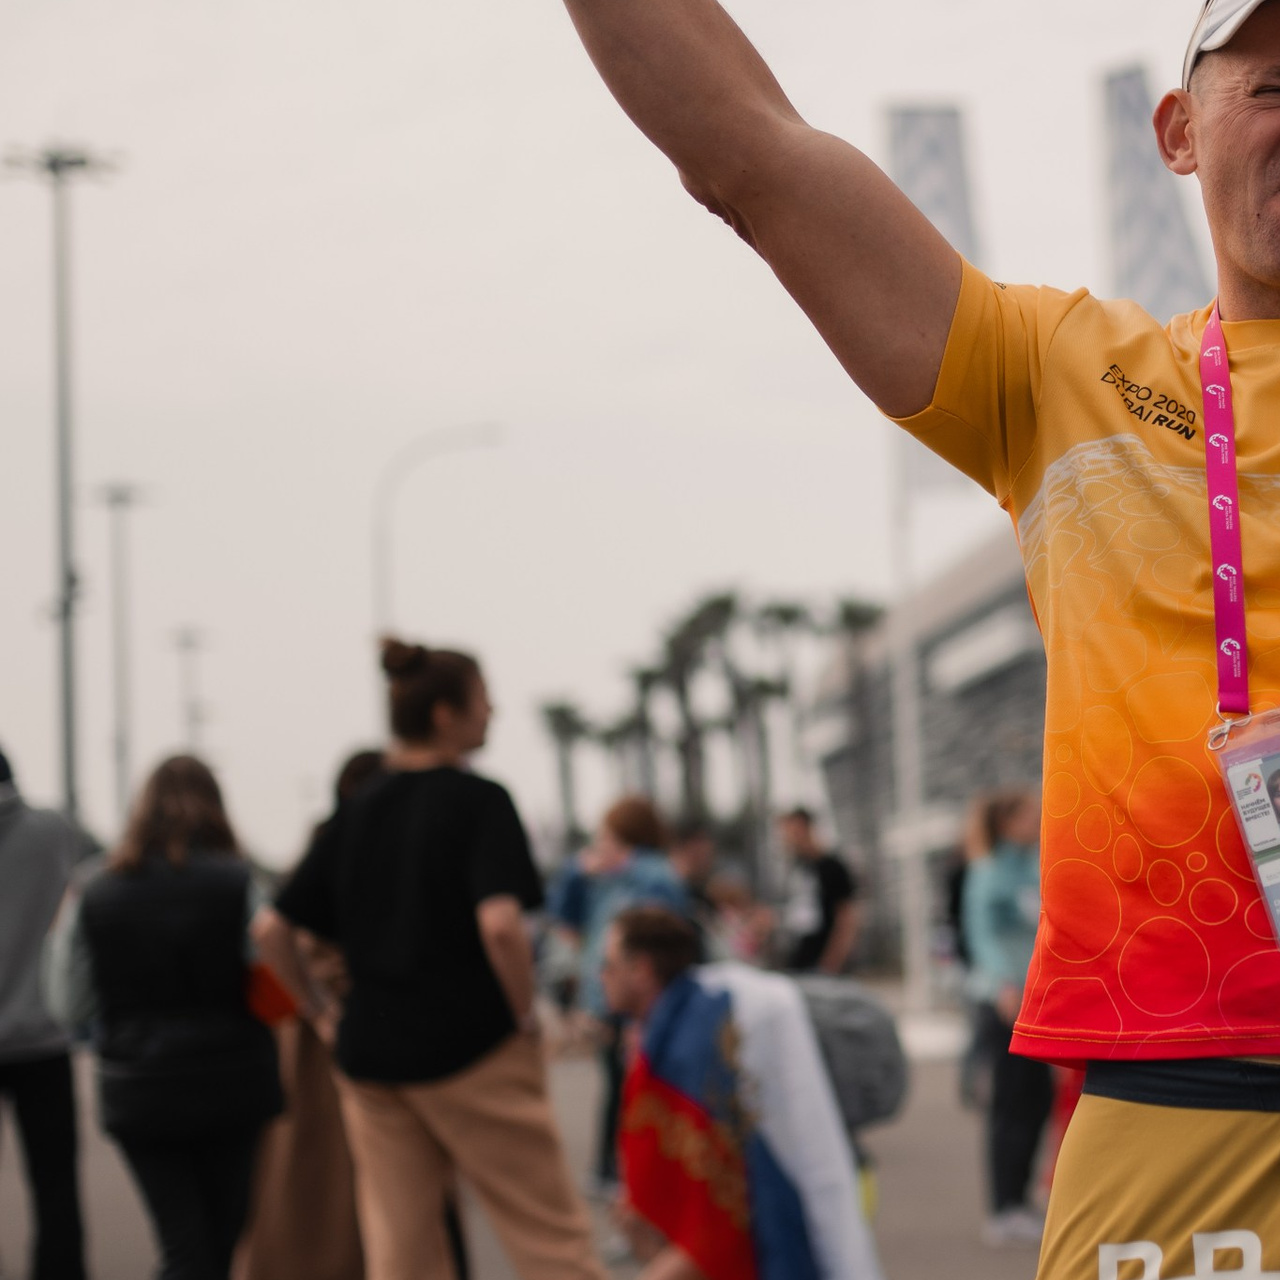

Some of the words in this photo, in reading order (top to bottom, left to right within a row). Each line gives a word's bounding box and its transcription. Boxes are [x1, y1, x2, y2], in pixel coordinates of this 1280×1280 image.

[1109, 364, 1153, 401] EXPO
[1152, 394, 1196, 425] 2020
[1152, 414, 1196, 440] RUN
